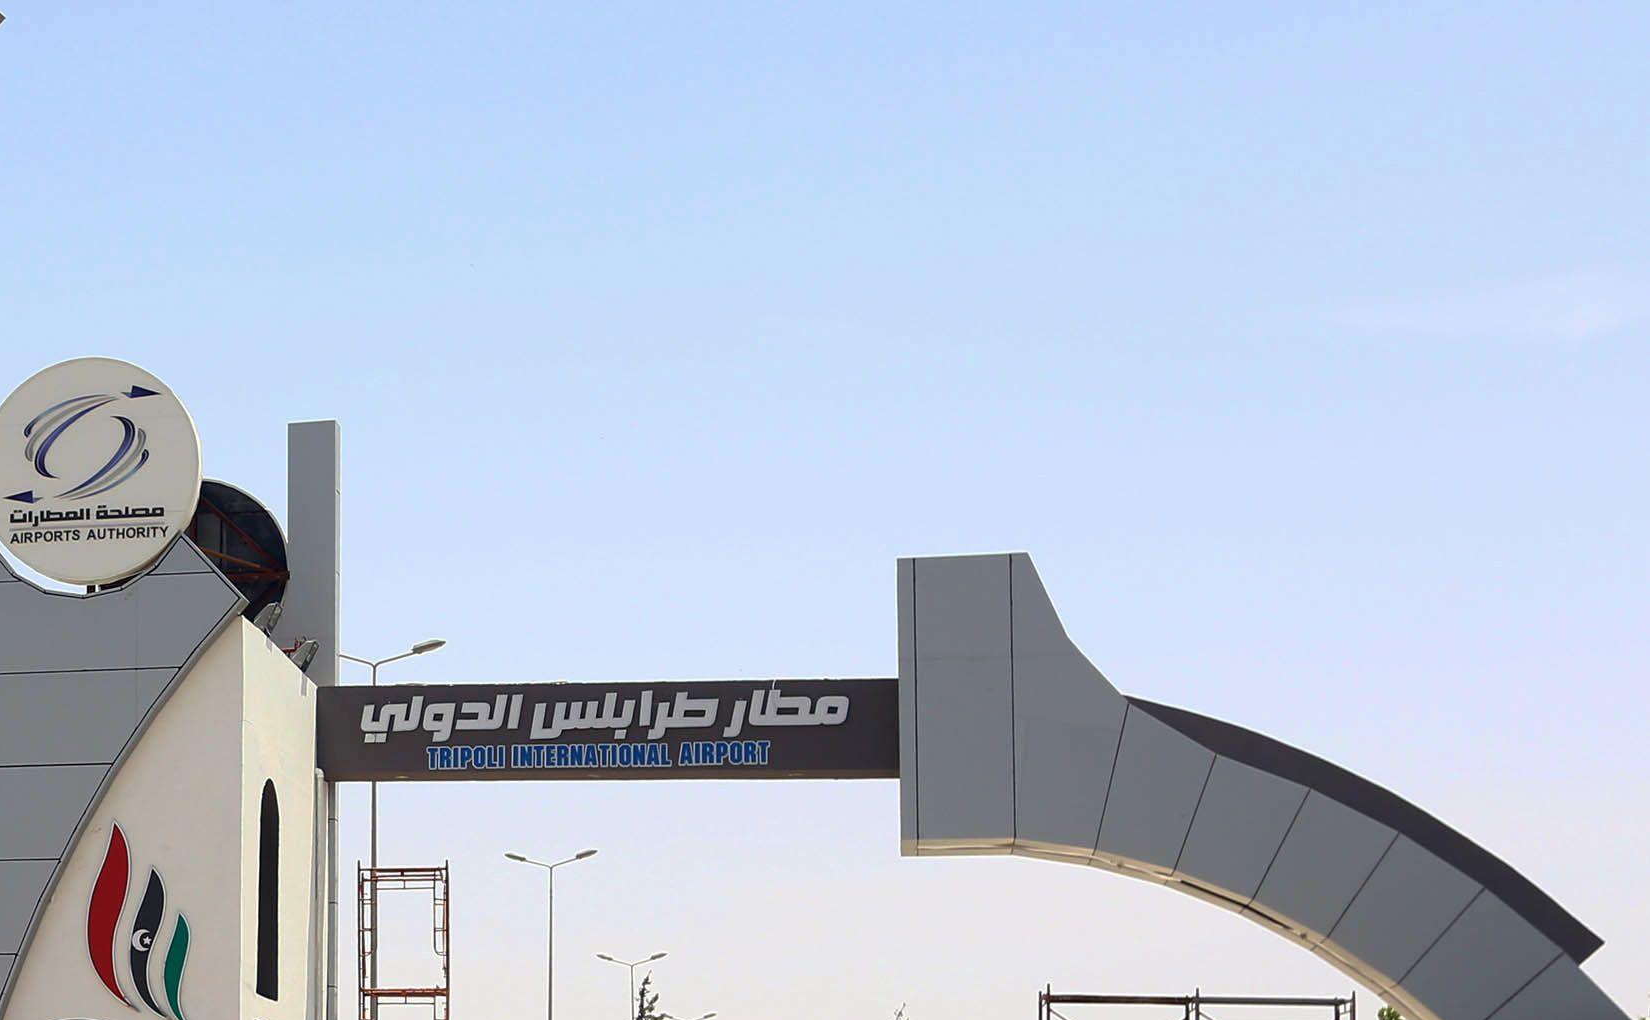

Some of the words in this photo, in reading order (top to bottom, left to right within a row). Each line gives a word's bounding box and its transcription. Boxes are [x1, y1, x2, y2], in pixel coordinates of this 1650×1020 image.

[10, 508, 91, 527] المطارات
[96, 505, 165, 520] مصلحة
[10, 529, 81, 545] AIRPORTS
[86, 526, 169, 541] AUTHORITY
[360, 693, 524, 744] الدولي
[529, 689, 720, 741] طرابلس
[722, 689, 850, 738] مطار
[426, 745, 506, 770] TRIPOLI
[510, 742, 673, 769] INTERNATIONAL
[678, 740, 771, 766] AIRPORT
